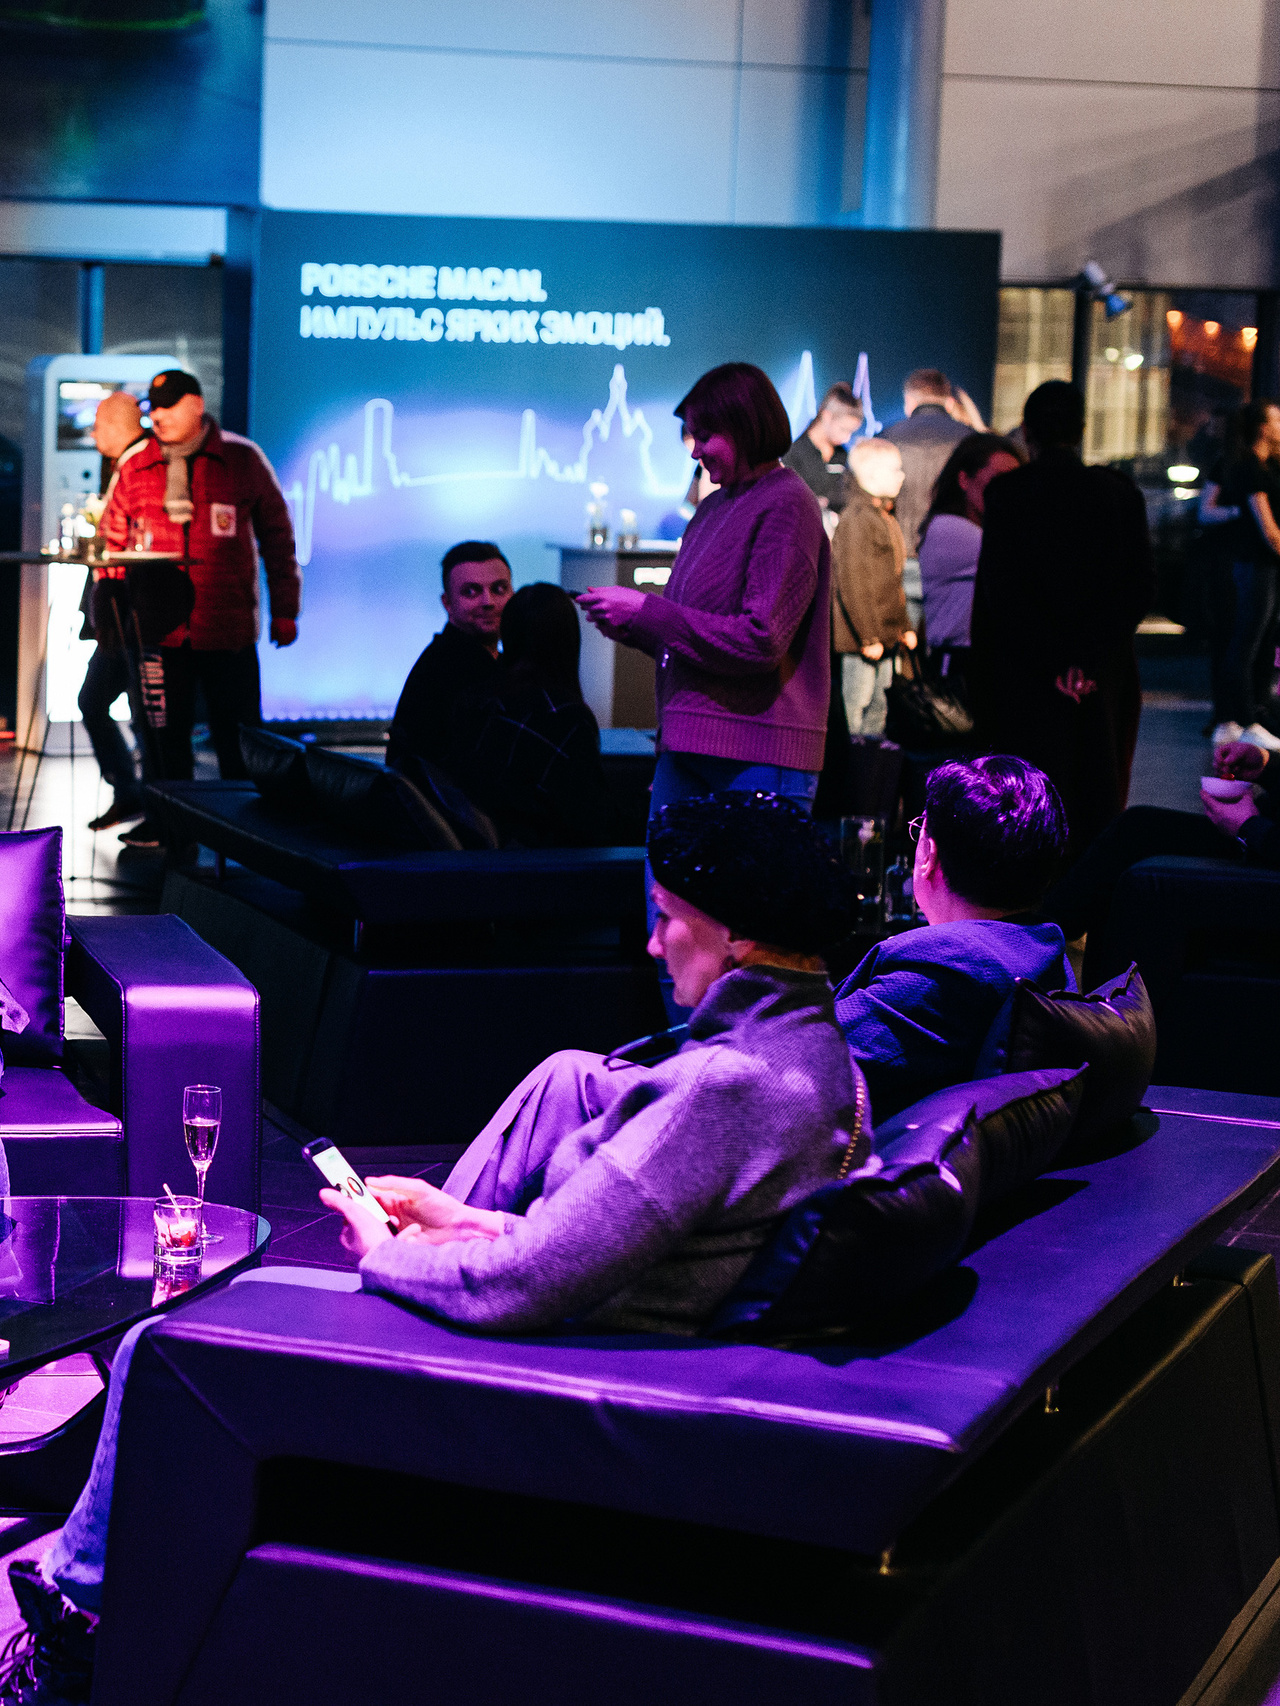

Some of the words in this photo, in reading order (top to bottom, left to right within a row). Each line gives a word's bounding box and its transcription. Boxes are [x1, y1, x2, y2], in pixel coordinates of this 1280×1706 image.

[301, 262, 437, 299] PORSCHE
[300, 305, 445, 342] ИМПУЛЬС
[445, 308, 539, 344] ЯРКИХ
[539, 307, 671, 350] ЭМОЦИЙ.
